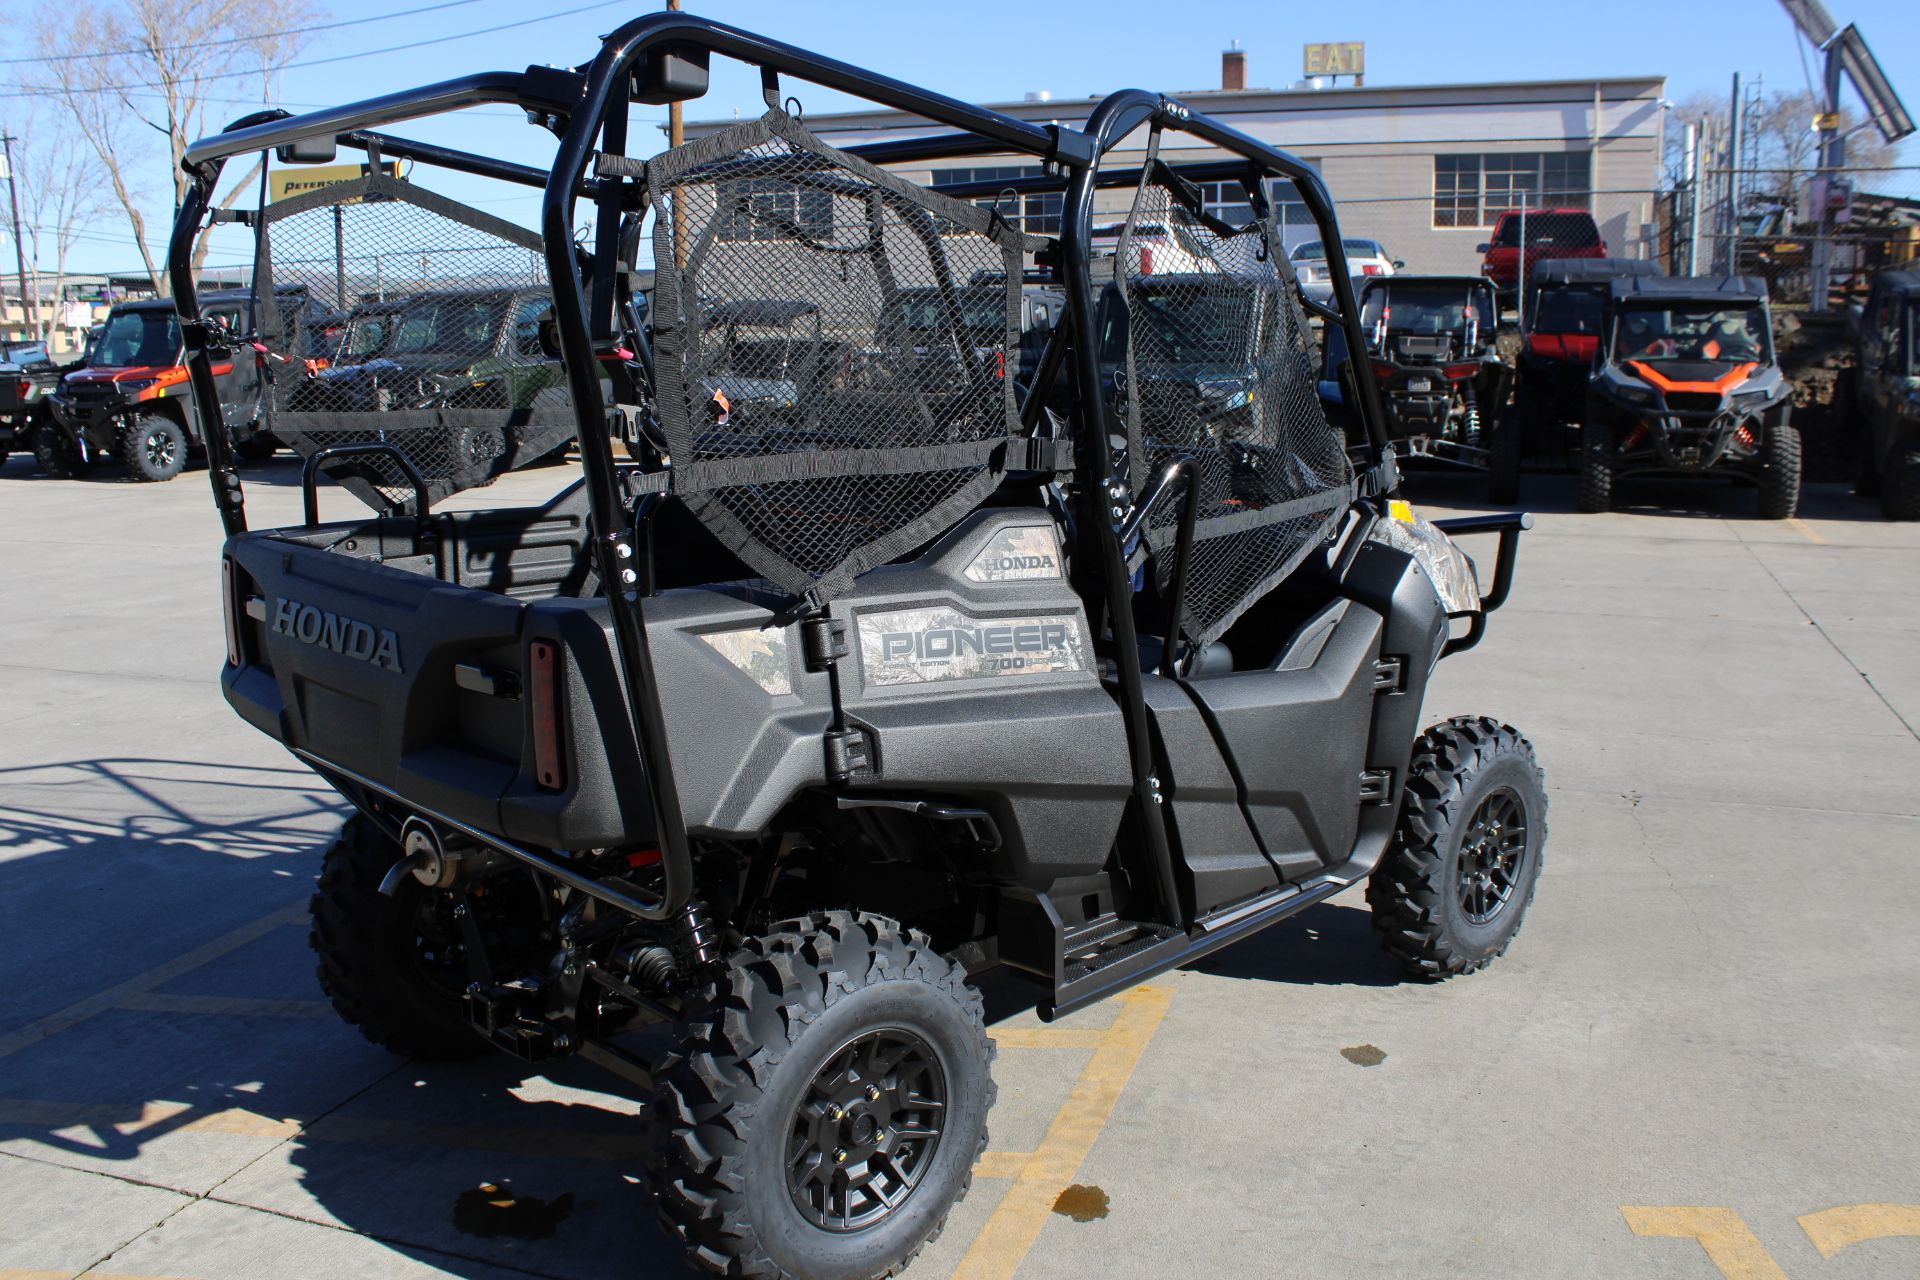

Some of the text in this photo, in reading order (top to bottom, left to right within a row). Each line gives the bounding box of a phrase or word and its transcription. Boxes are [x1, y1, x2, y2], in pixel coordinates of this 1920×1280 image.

[1306, 44, 1362, 72] EAT
[284, 179, 350, 194] PETERSO
[984, 555, 1055, 571] HONDA
[272, 597, 403, 673] HONDA
[881, 624, 1067, 662] PIONEER
[920, 659, 950, 667] EDITION
[987, 657, 1025, 670] 700
